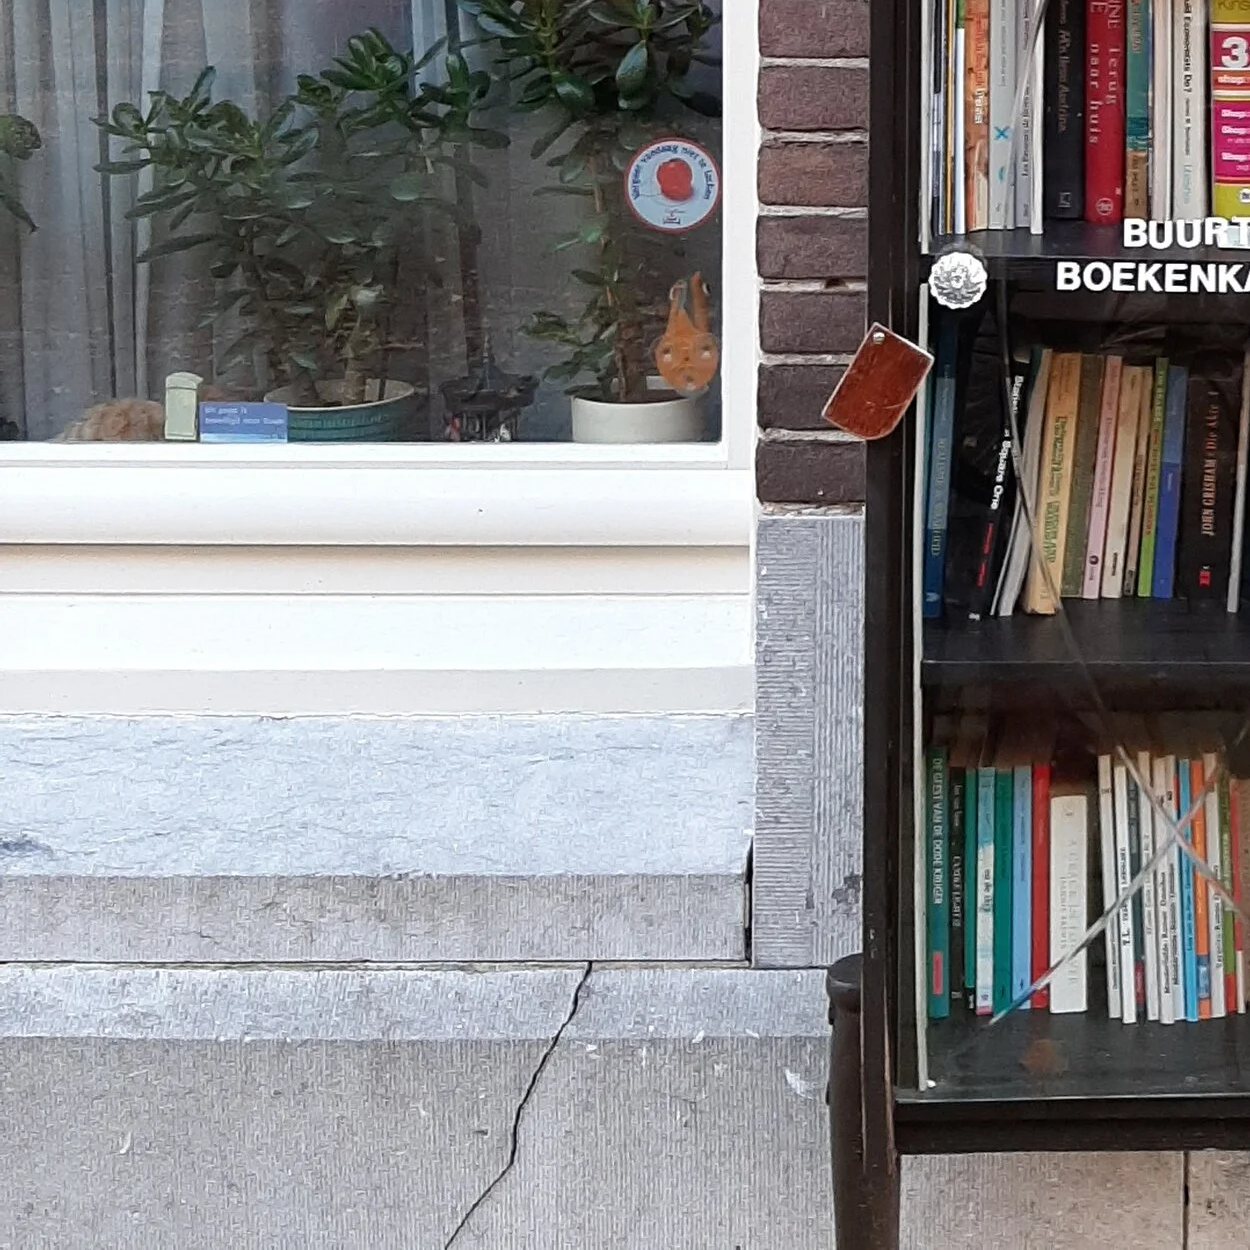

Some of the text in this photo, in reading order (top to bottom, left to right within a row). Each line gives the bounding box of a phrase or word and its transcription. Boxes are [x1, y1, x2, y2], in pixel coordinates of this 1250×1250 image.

[1089, 43, 1101, 90] naar
[1089, 99, 1103, 144] huis
[996, 440, 1012, 482] Square
[1202, 459, 1217, 506] GRISHAM
[990, 485, 1004, 510] One
[1201, 509, 1215, 536] JOHN
[932, 757, 943, 770] DE
[932, 772, 943, 800] GEEST
[932, 802, 943, 823] VAN
[932, 825, 943, 837] DE
[932, 839, 943, 866] DODE
